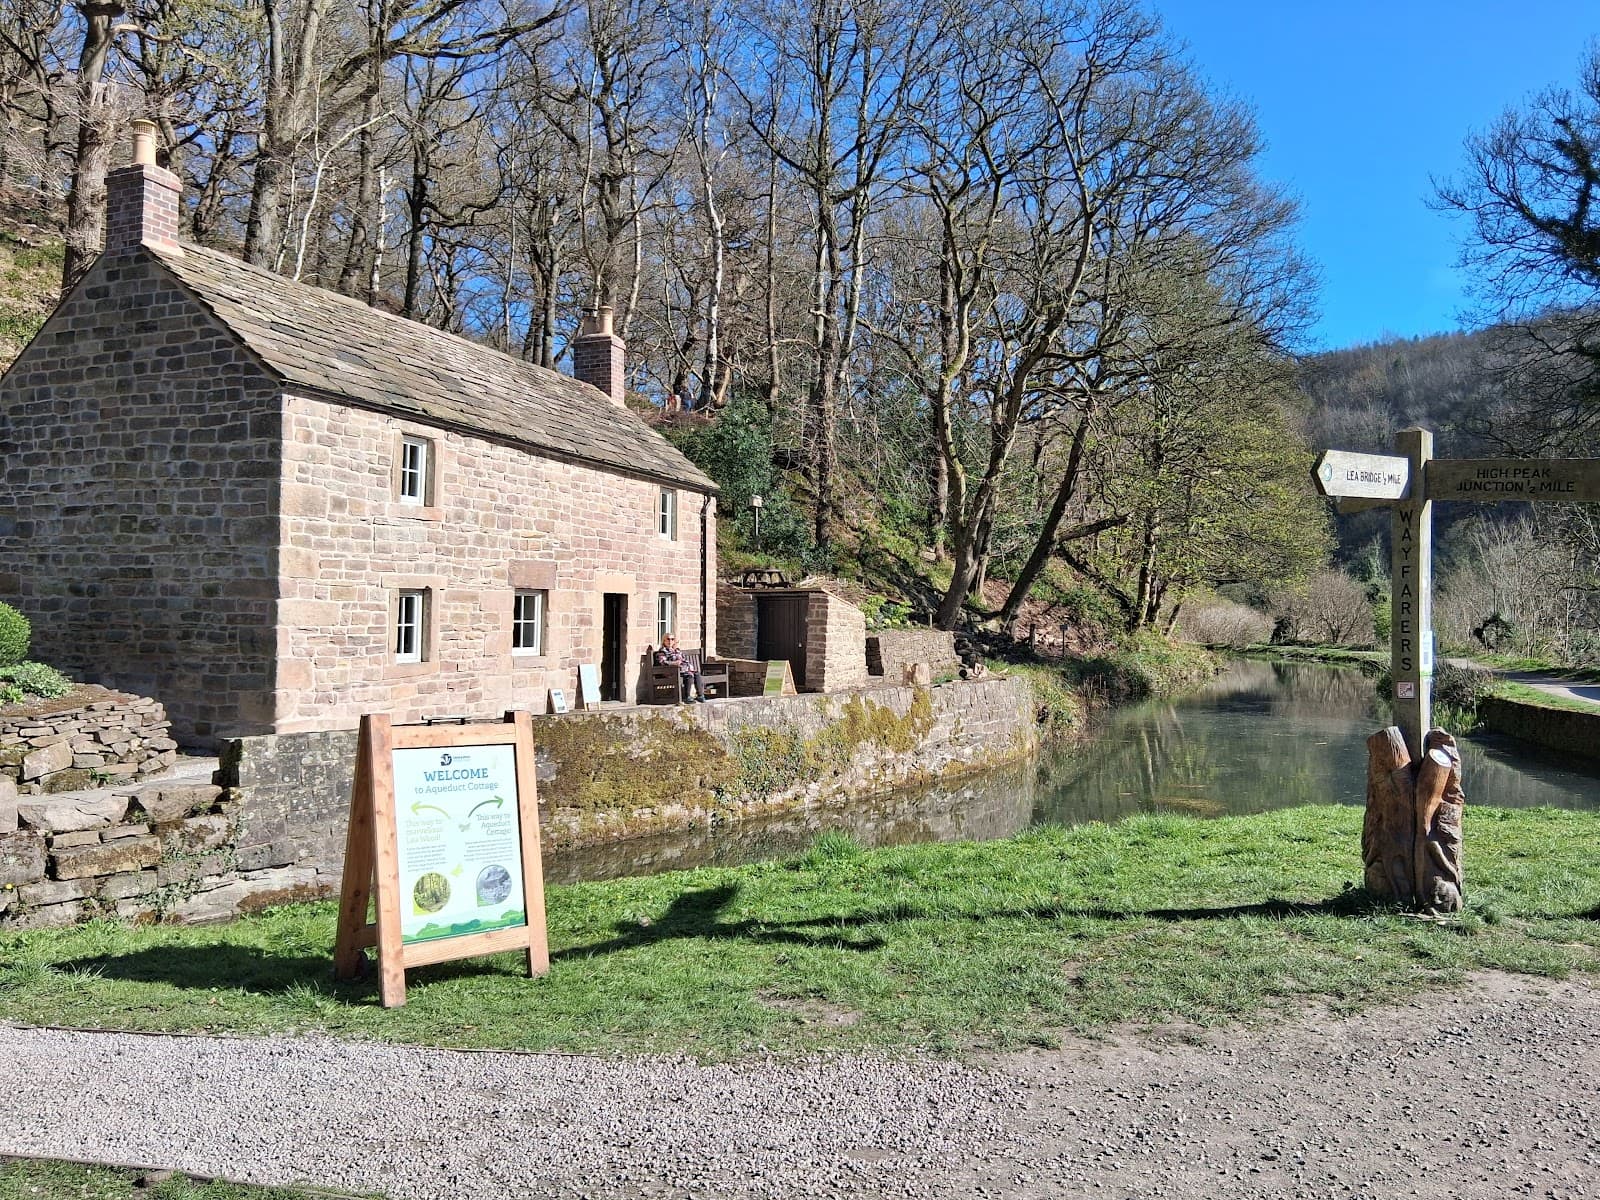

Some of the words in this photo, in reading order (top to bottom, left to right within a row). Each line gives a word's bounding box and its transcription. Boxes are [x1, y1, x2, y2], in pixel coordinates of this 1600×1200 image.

[1346, 470, 1359, 481] LEA
[1360, 471, 1382, 483] BRIDGE
[1387, 473, 1401, 485] MILE
[1476, 468, 1509, 479] HIGH
[1513, 468, 1551, 479] PEAK
[1456, 480, 1524, 492] JUNCTION
[1540, 480, 1576, 492] MILE
[1399, 508, 1413, 672] WAYFARERS
[424, 768, 489, 782] WELCOME
[425, 783, 466, 795] Aqueduct
[467, 782, 499, 791] Cottage
